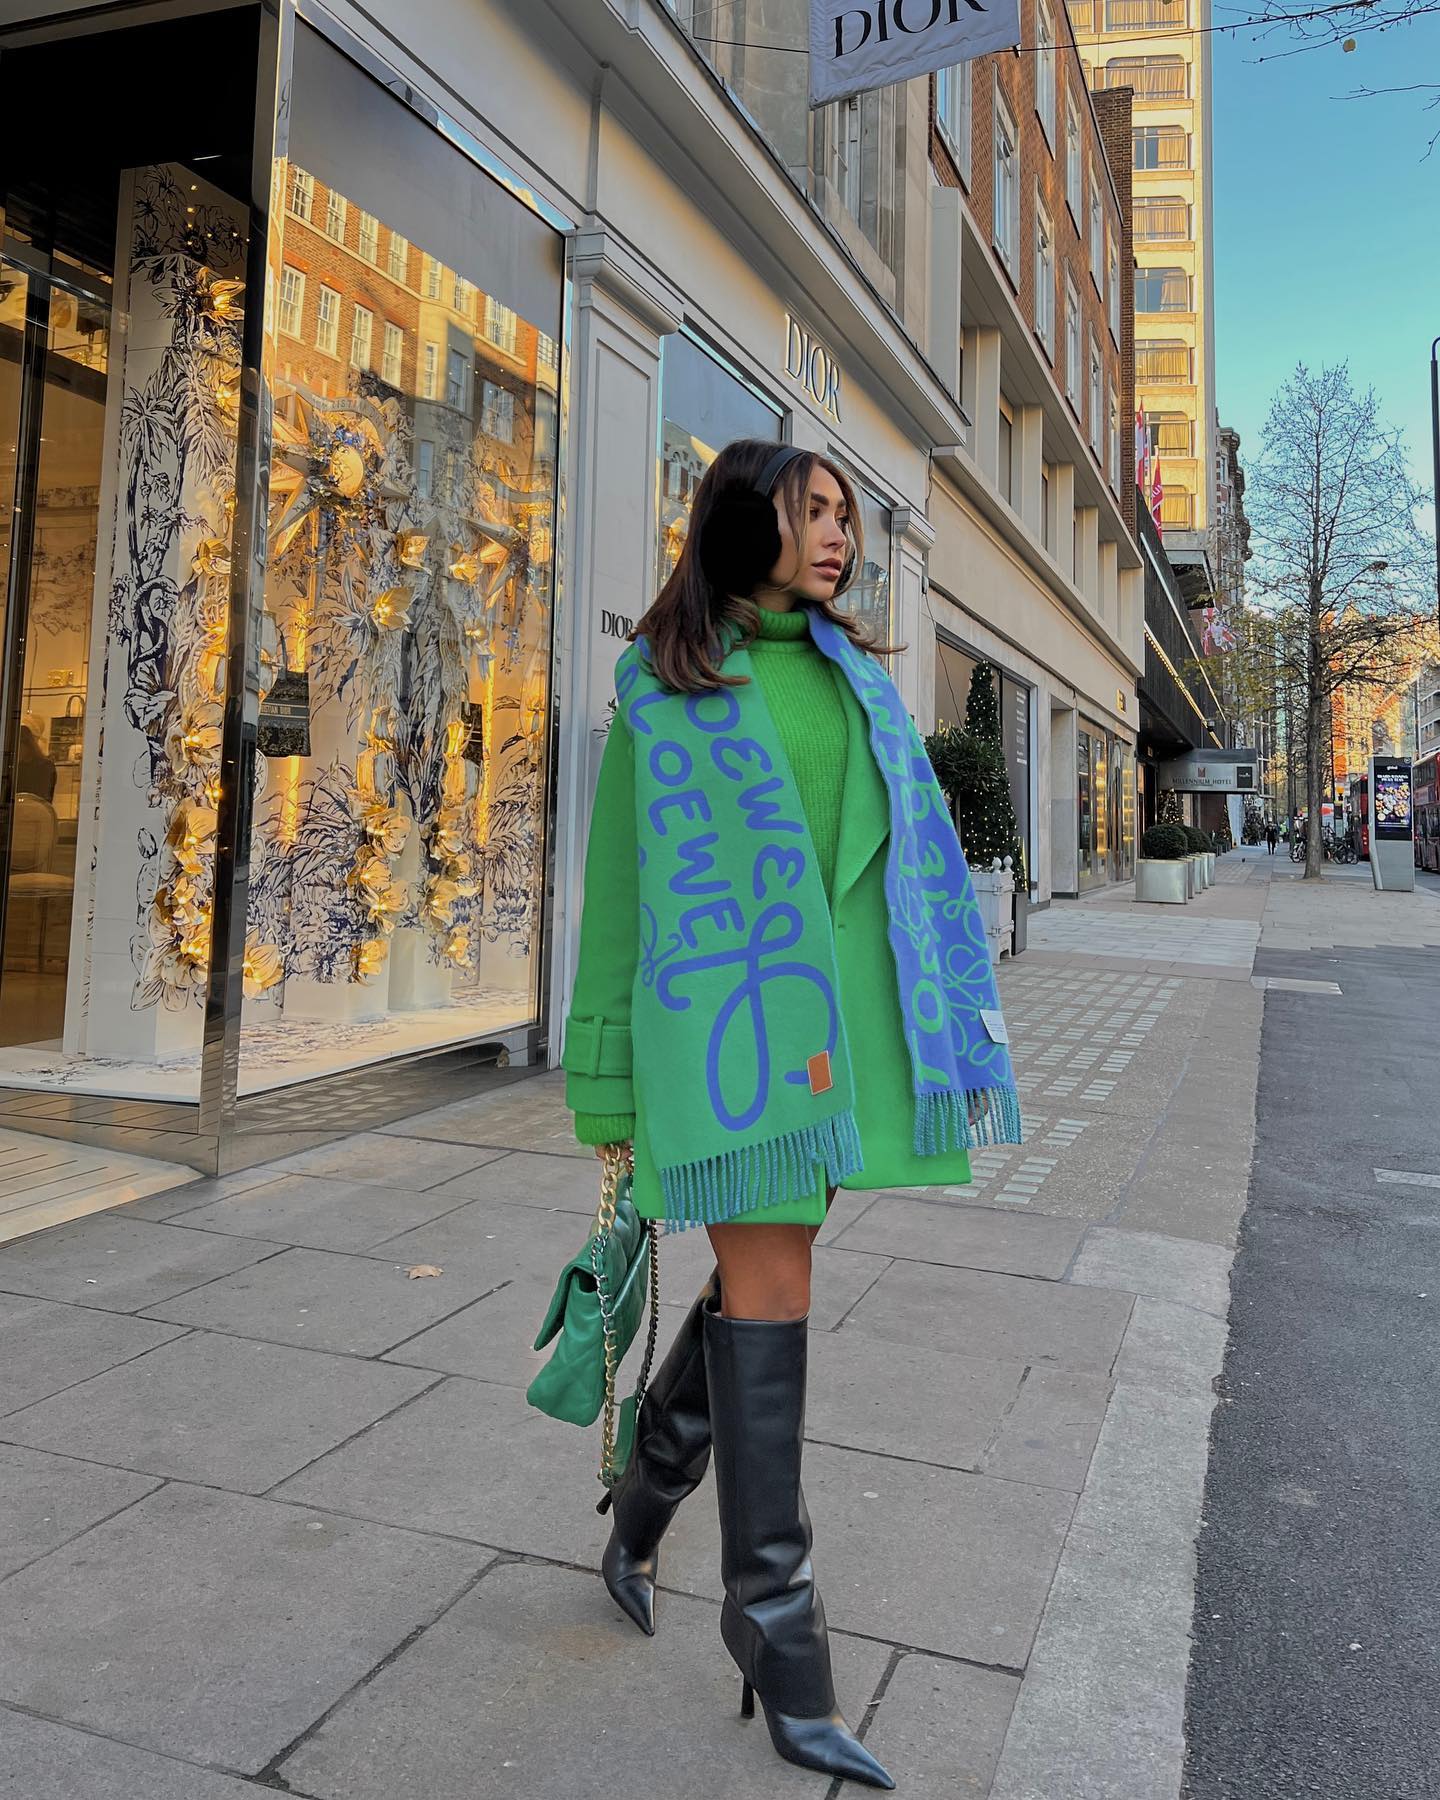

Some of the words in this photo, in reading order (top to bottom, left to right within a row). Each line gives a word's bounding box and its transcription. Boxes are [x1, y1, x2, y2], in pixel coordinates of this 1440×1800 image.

[785, 313, 842, 423] DIOR
[601, 609, 633, 638] DIOR
[629, 689, 745, 949] LOEWE
[686, 687, 805, 899] OEWE
